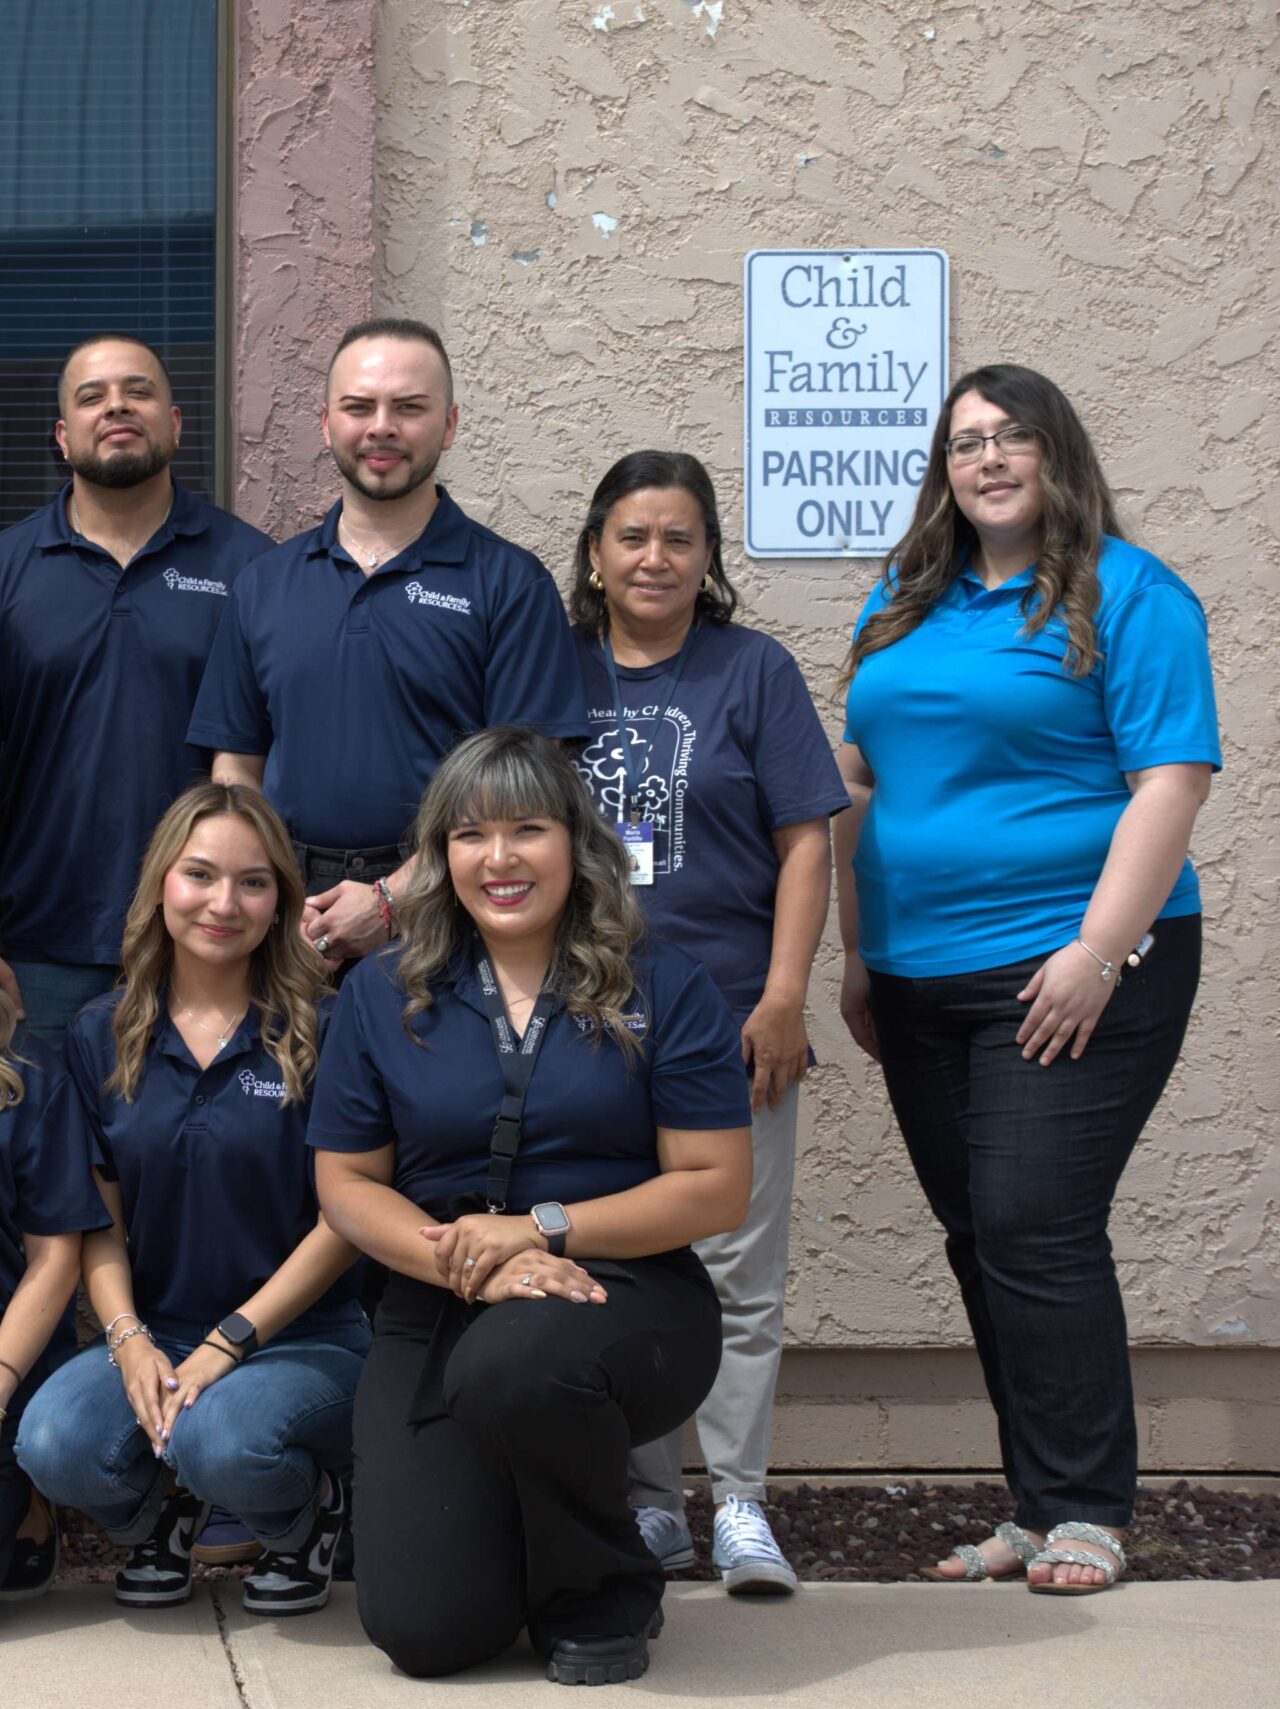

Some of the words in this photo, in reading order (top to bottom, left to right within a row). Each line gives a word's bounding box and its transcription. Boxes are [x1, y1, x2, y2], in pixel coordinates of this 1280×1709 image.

[781, 264, 911, 308] Child
[826, 317, 868, 349] &
[764, 350, 928, 403] Family
[769, 410, 924, 425] RESOURCES
[762, 449, 929, 487] PARKING
[796, 499, 894, 537] ONLY
[178, 576, 197, 585] Child
[418, 597, 462, 612] RESOURCES
[420, 590, 440, 600] Child
[446, 594, 471, 608] Family
[587, 707, 640, 719] Healhy
[642, 705, 692, 731] Chldren,
[674, 730, 696, 777] Thriving
[673, 779, 688, 872] Communities.
[253, 1088, 288, 1098] RESOUR
[254, 1080, 275, 1090] Child
